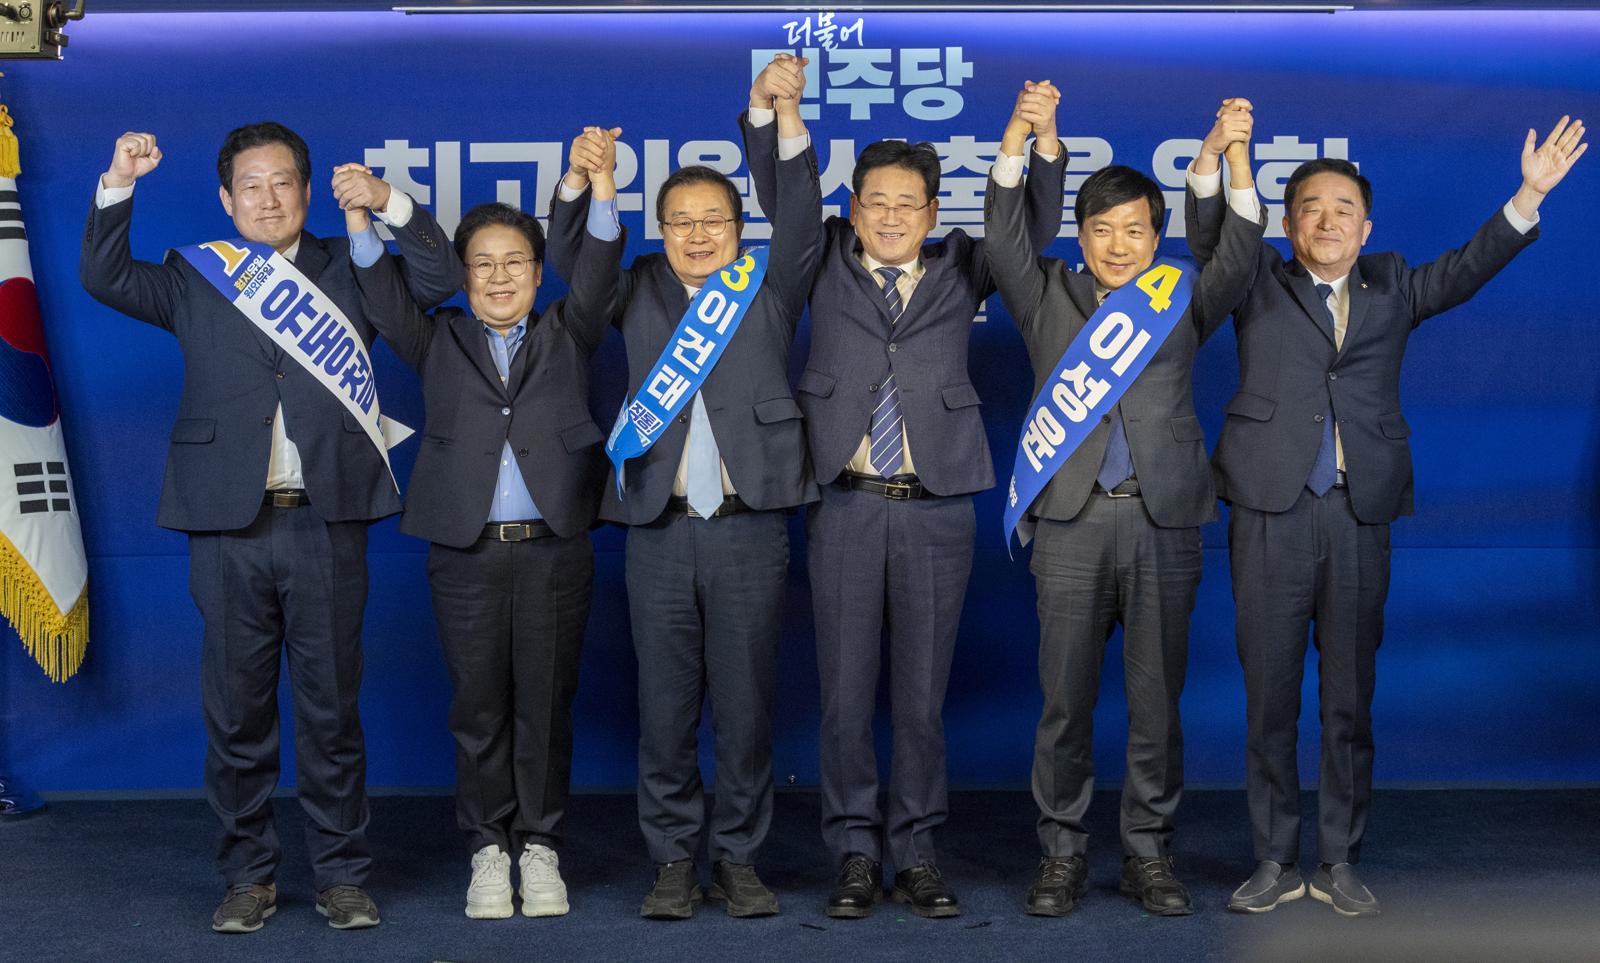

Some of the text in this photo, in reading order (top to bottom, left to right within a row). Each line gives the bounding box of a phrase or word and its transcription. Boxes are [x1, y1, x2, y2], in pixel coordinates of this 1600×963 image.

[782, 11, 864, 52] 더불어
[198, 240, 252, 278] 1
[720, 255, 756, 292] 3
[1135, 263, 1183, 314] 4
[260, 279, 376, 415] 유동철
[647, 290, 740, 411] 이건태
[1021, 311, 1152, 473] 이성윤
